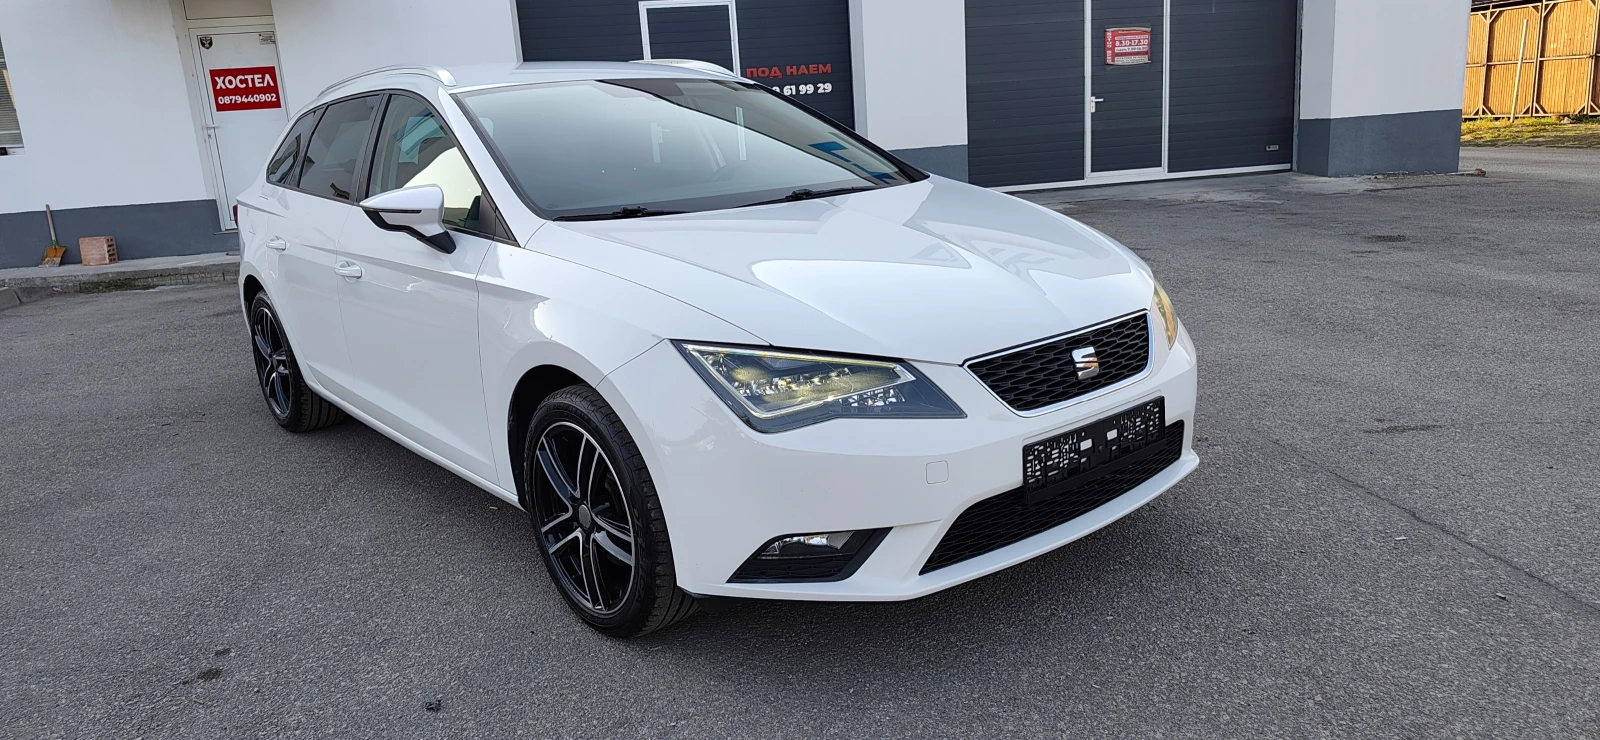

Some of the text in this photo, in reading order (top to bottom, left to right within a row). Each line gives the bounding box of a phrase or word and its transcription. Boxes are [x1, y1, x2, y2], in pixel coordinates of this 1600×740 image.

[746, 64, 832, 78] ПОД НАЕМ
[214, 74, 274, 89] ХОСТЕЛ
[783, 85, 796, 96] 61
[799, 84, 814, 95] 99
[817, 83, 832, 94] 29
[218, 93, 277, 104] 0879440902
